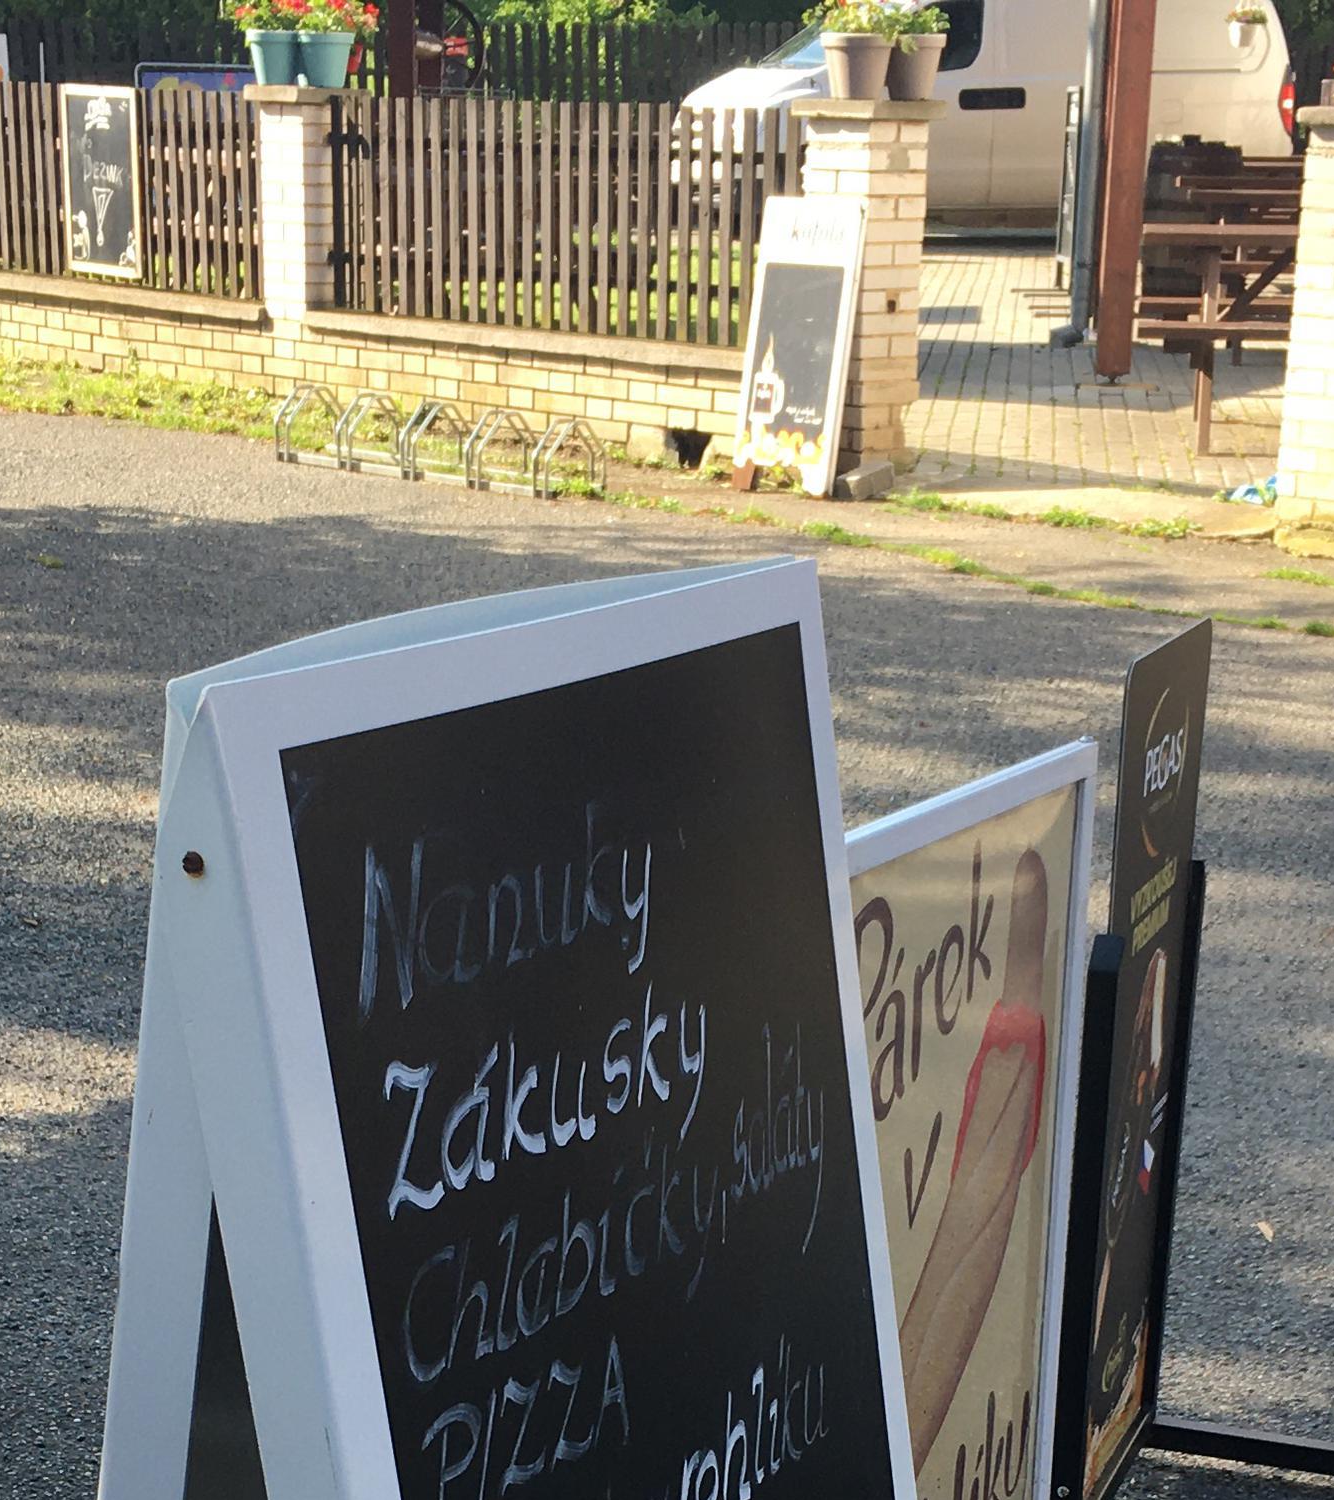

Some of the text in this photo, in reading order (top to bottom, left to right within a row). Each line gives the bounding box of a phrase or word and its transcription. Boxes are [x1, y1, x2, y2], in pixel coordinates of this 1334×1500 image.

[1142, 728, 1184, 798] PEGAS
[358, 802, 652, 1020] Nanuky
[853, 838, 994, 1122] Párek
[383, 978, 707, 1221] Zákusky
